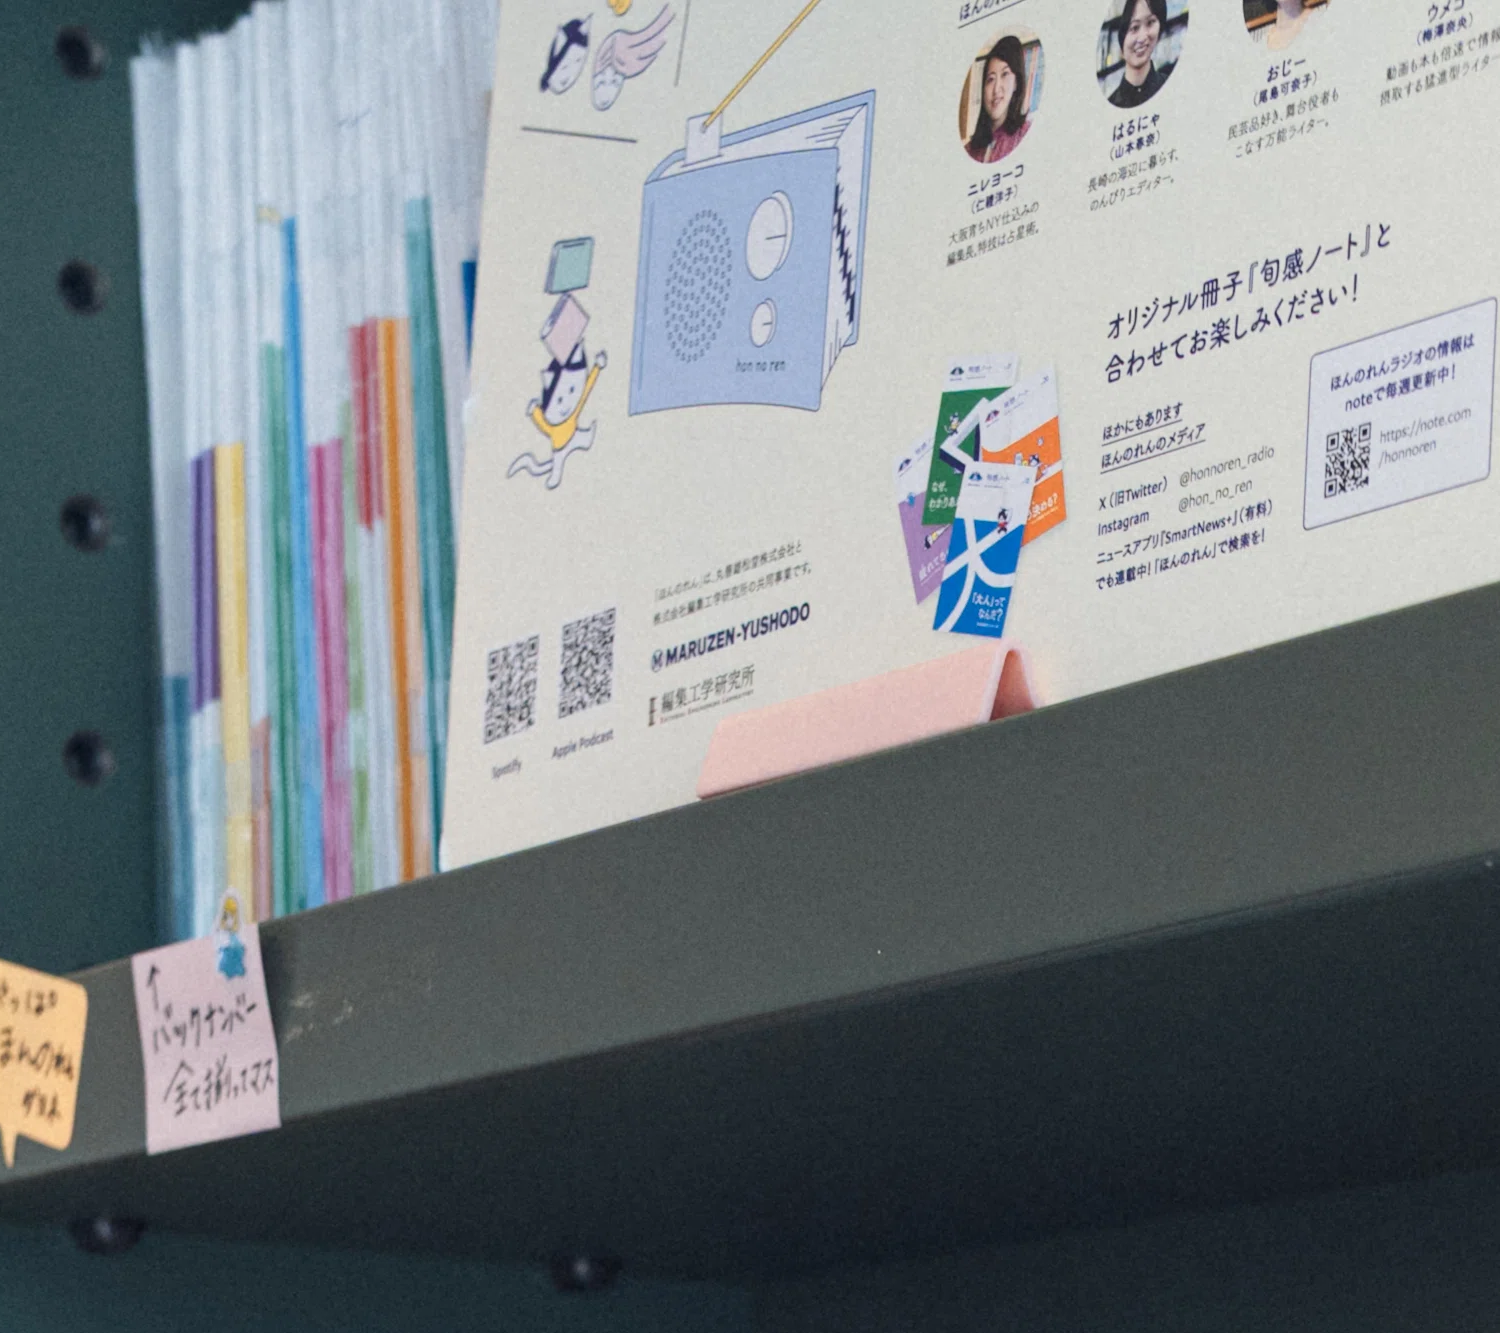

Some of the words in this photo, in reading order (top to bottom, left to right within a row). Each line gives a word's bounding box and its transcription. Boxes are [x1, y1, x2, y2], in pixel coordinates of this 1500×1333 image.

[1268, 58, 1306, 82] おじー
[1112, 114, 1160, 142] はるにゃ
[968, 165, 1024, 196] ニレヨーコ
[1090, 176, 1174, 211] のんびりエディター。
[1106, 223, 1391, 340] オリジナル冊子『旬感ノート』と
[1106, 274, 1359, 383] 合わせてお楽しみください！
[1330, 333, 1475, 391] ほんのれんラジオの情報は
[1345, 364, 1457, 412] noteで毎週更新中！
[1102, 403, 1184, 440] ほかにもあります
[1379, 407, 1472, 444] https://note.com
[1101, 423, 1206, 469] ほんのれんのメディア
[1179, 446, 1275, 487] @honnoren_radio
[1378, 439, 1437, 468] /honnoren
[1098, 510, 1150, 535] Instagram
[1179, 478, 1253, 512] @hon_no_ren
[665, 603, 811, 668] MARUZEN-YUSHODO
[661, 664, 755, 712] 編集工学研究所
[579, 728, 614, 752] Podcast
